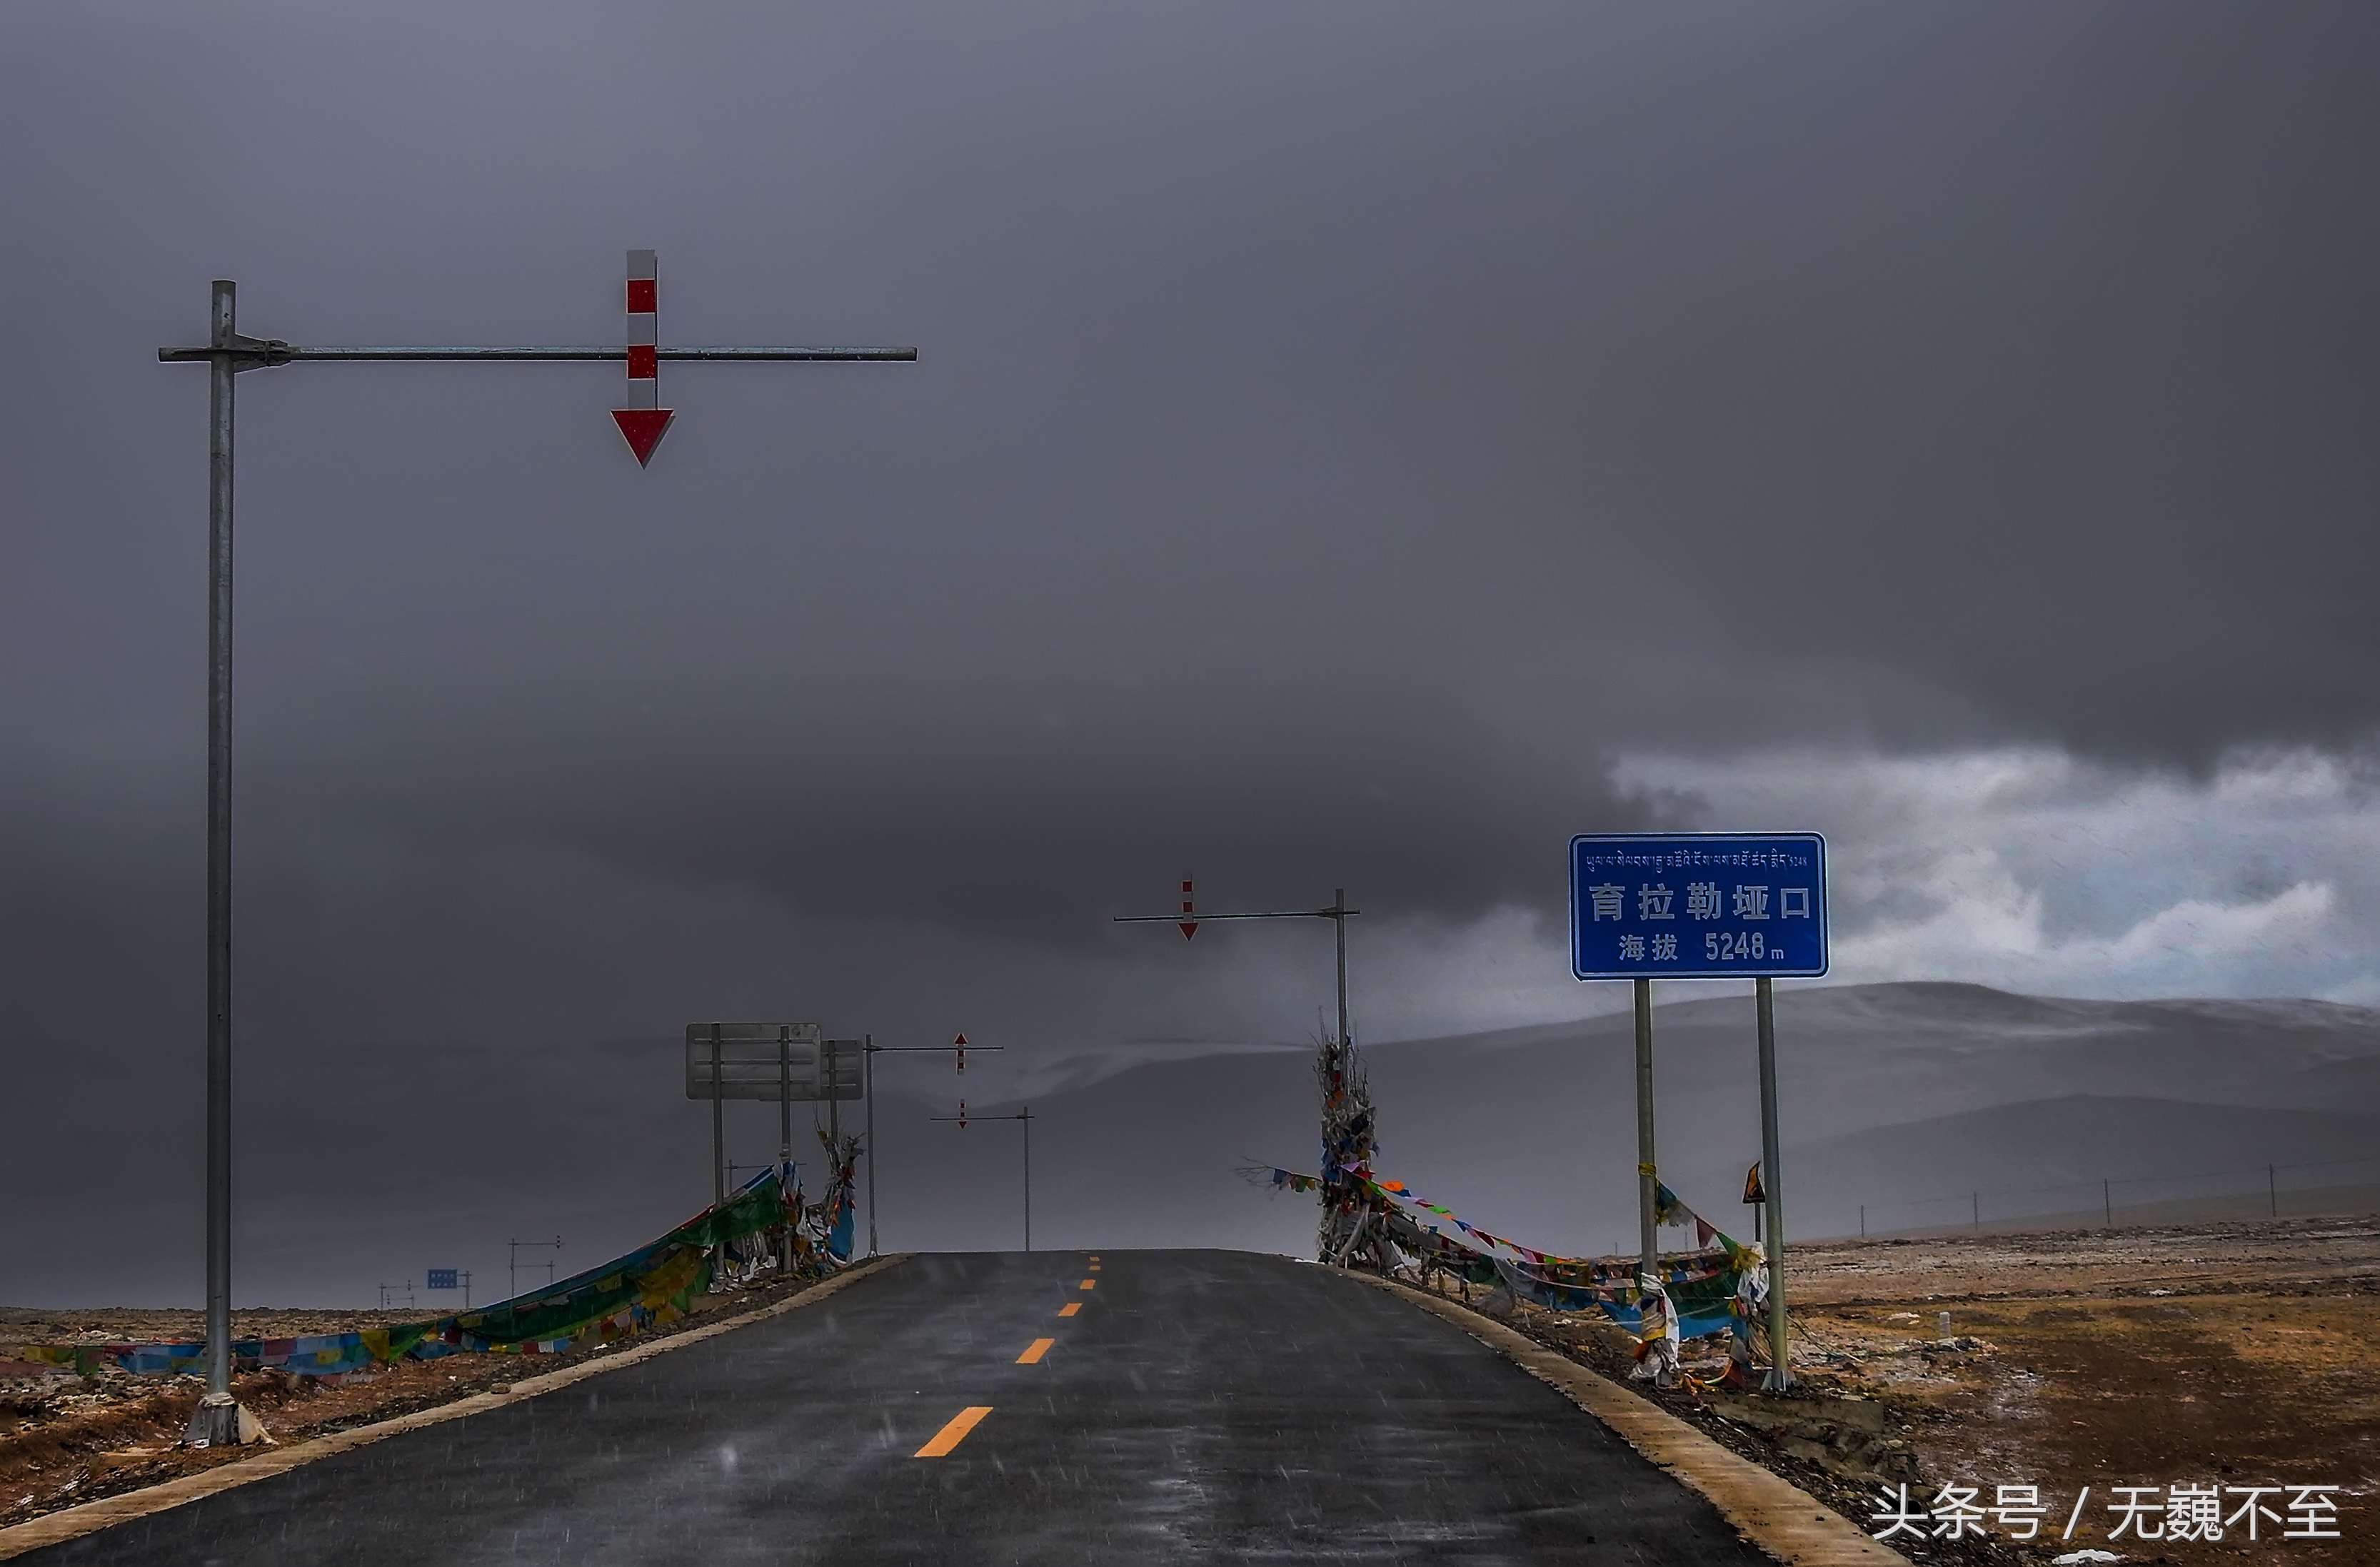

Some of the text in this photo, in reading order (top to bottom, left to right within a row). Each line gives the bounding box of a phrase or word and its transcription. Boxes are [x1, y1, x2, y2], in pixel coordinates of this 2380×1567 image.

[1588, 882, 1810, 922] 育拉勒垭口
[1618, 933, 1679, 961] 海拔
